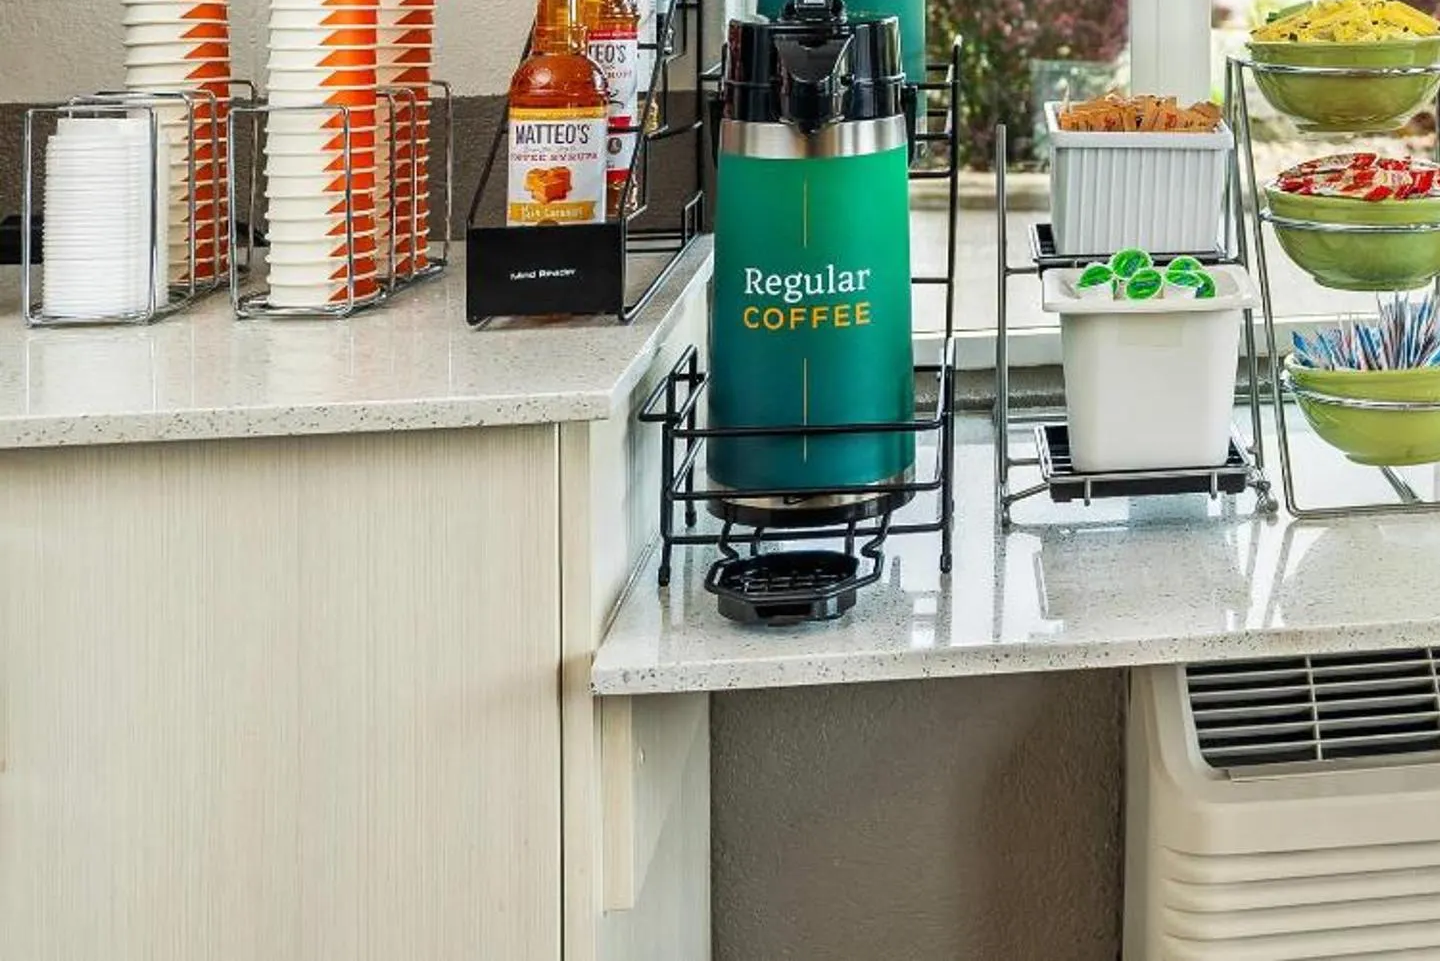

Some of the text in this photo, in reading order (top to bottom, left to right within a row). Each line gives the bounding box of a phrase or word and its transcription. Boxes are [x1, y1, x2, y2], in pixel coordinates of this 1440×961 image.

[516, 124, 590, 144] MATTEO'S
[744, 264, 871, 303] Regular
[743, 302, 871, 330] COFFEE
